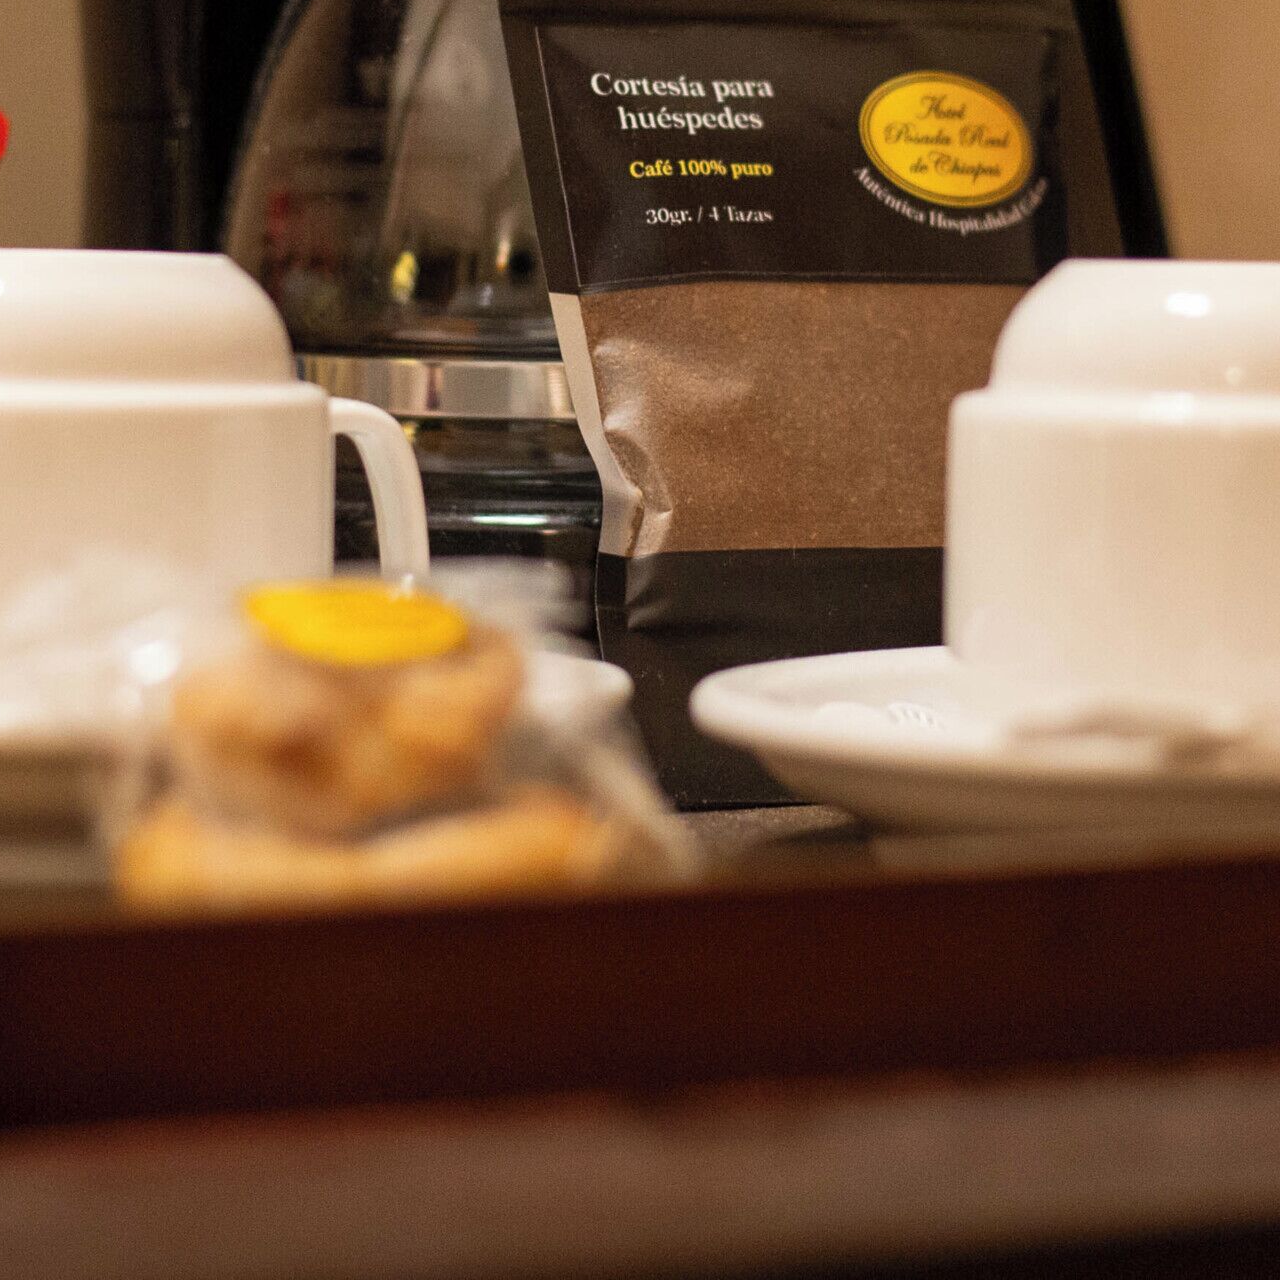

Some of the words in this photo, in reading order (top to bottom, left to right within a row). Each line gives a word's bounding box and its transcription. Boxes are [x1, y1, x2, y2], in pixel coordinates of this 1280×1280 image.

[591, 73, 705, 96] Cortesía
[712, 81, 773, 102] para
[618, 107, 763, 135] huéspedes
[629, 160, 673, 178] Café
[679, 160, 726, 176] 100%
[731, 163, 773, 179] puro
[645, 208, 692, 225] 30gr.
[723, 206, 773, 222] Tazas
